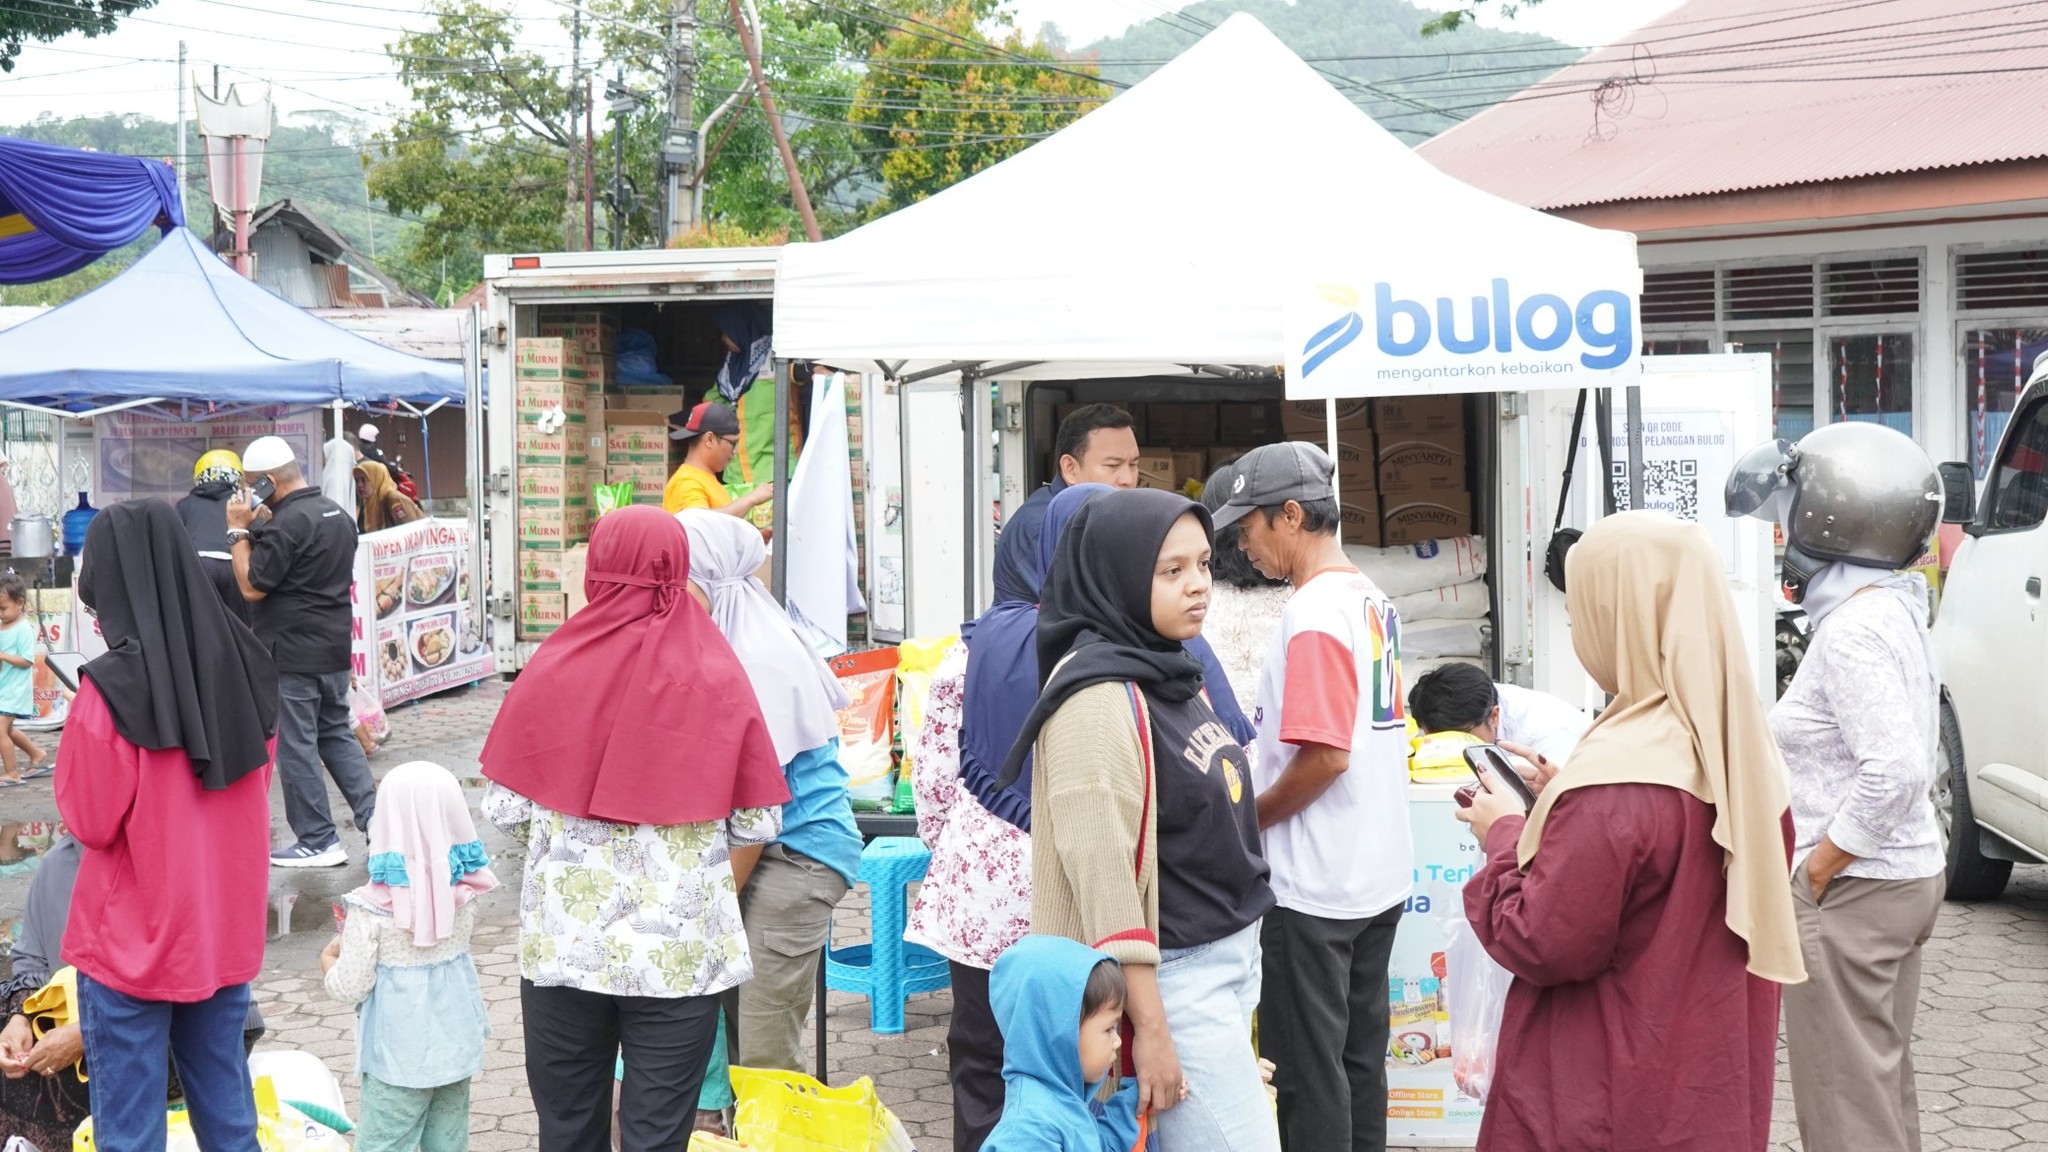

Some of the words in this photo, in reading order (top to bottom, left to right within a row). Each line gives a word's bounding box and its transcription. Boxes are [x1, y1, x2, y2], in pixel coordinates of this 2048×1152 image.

[1374, 277, 1633, 370] bulog
[527, 351, 558, 364] MURNI
[1377, 363, 1496, 382] mengantarkan
[1501, 360, 1574, 376] kebaikan
[1647, 422, 1659, 432] QR
[1661, 421, 1683, 432] CODE
[529, 439, 561, 450] MURNI
[609, 438, 631, 450] SARI
[633, 438, 664, 450] MURNI
[1645, 436, 1695, 447] PELANGGAN
[1697, 434, 1725, 446] BULOG
[1391, 451, 1453, 468] MINYAKITA
[528, 482, 560, 494] MURNI
[633, 480, 664, 492] MURNI
[1396, 510, 1458, 526] MINYAKITA
[528, 524, 560, 536] MURNI
[530, 608, 561, 620] MURNI
[1388, 1090, 1416, 1099] Offline
[1417, 1091, 1439, 1099] Store
[1416, 1108, 1438, 1117] Store
